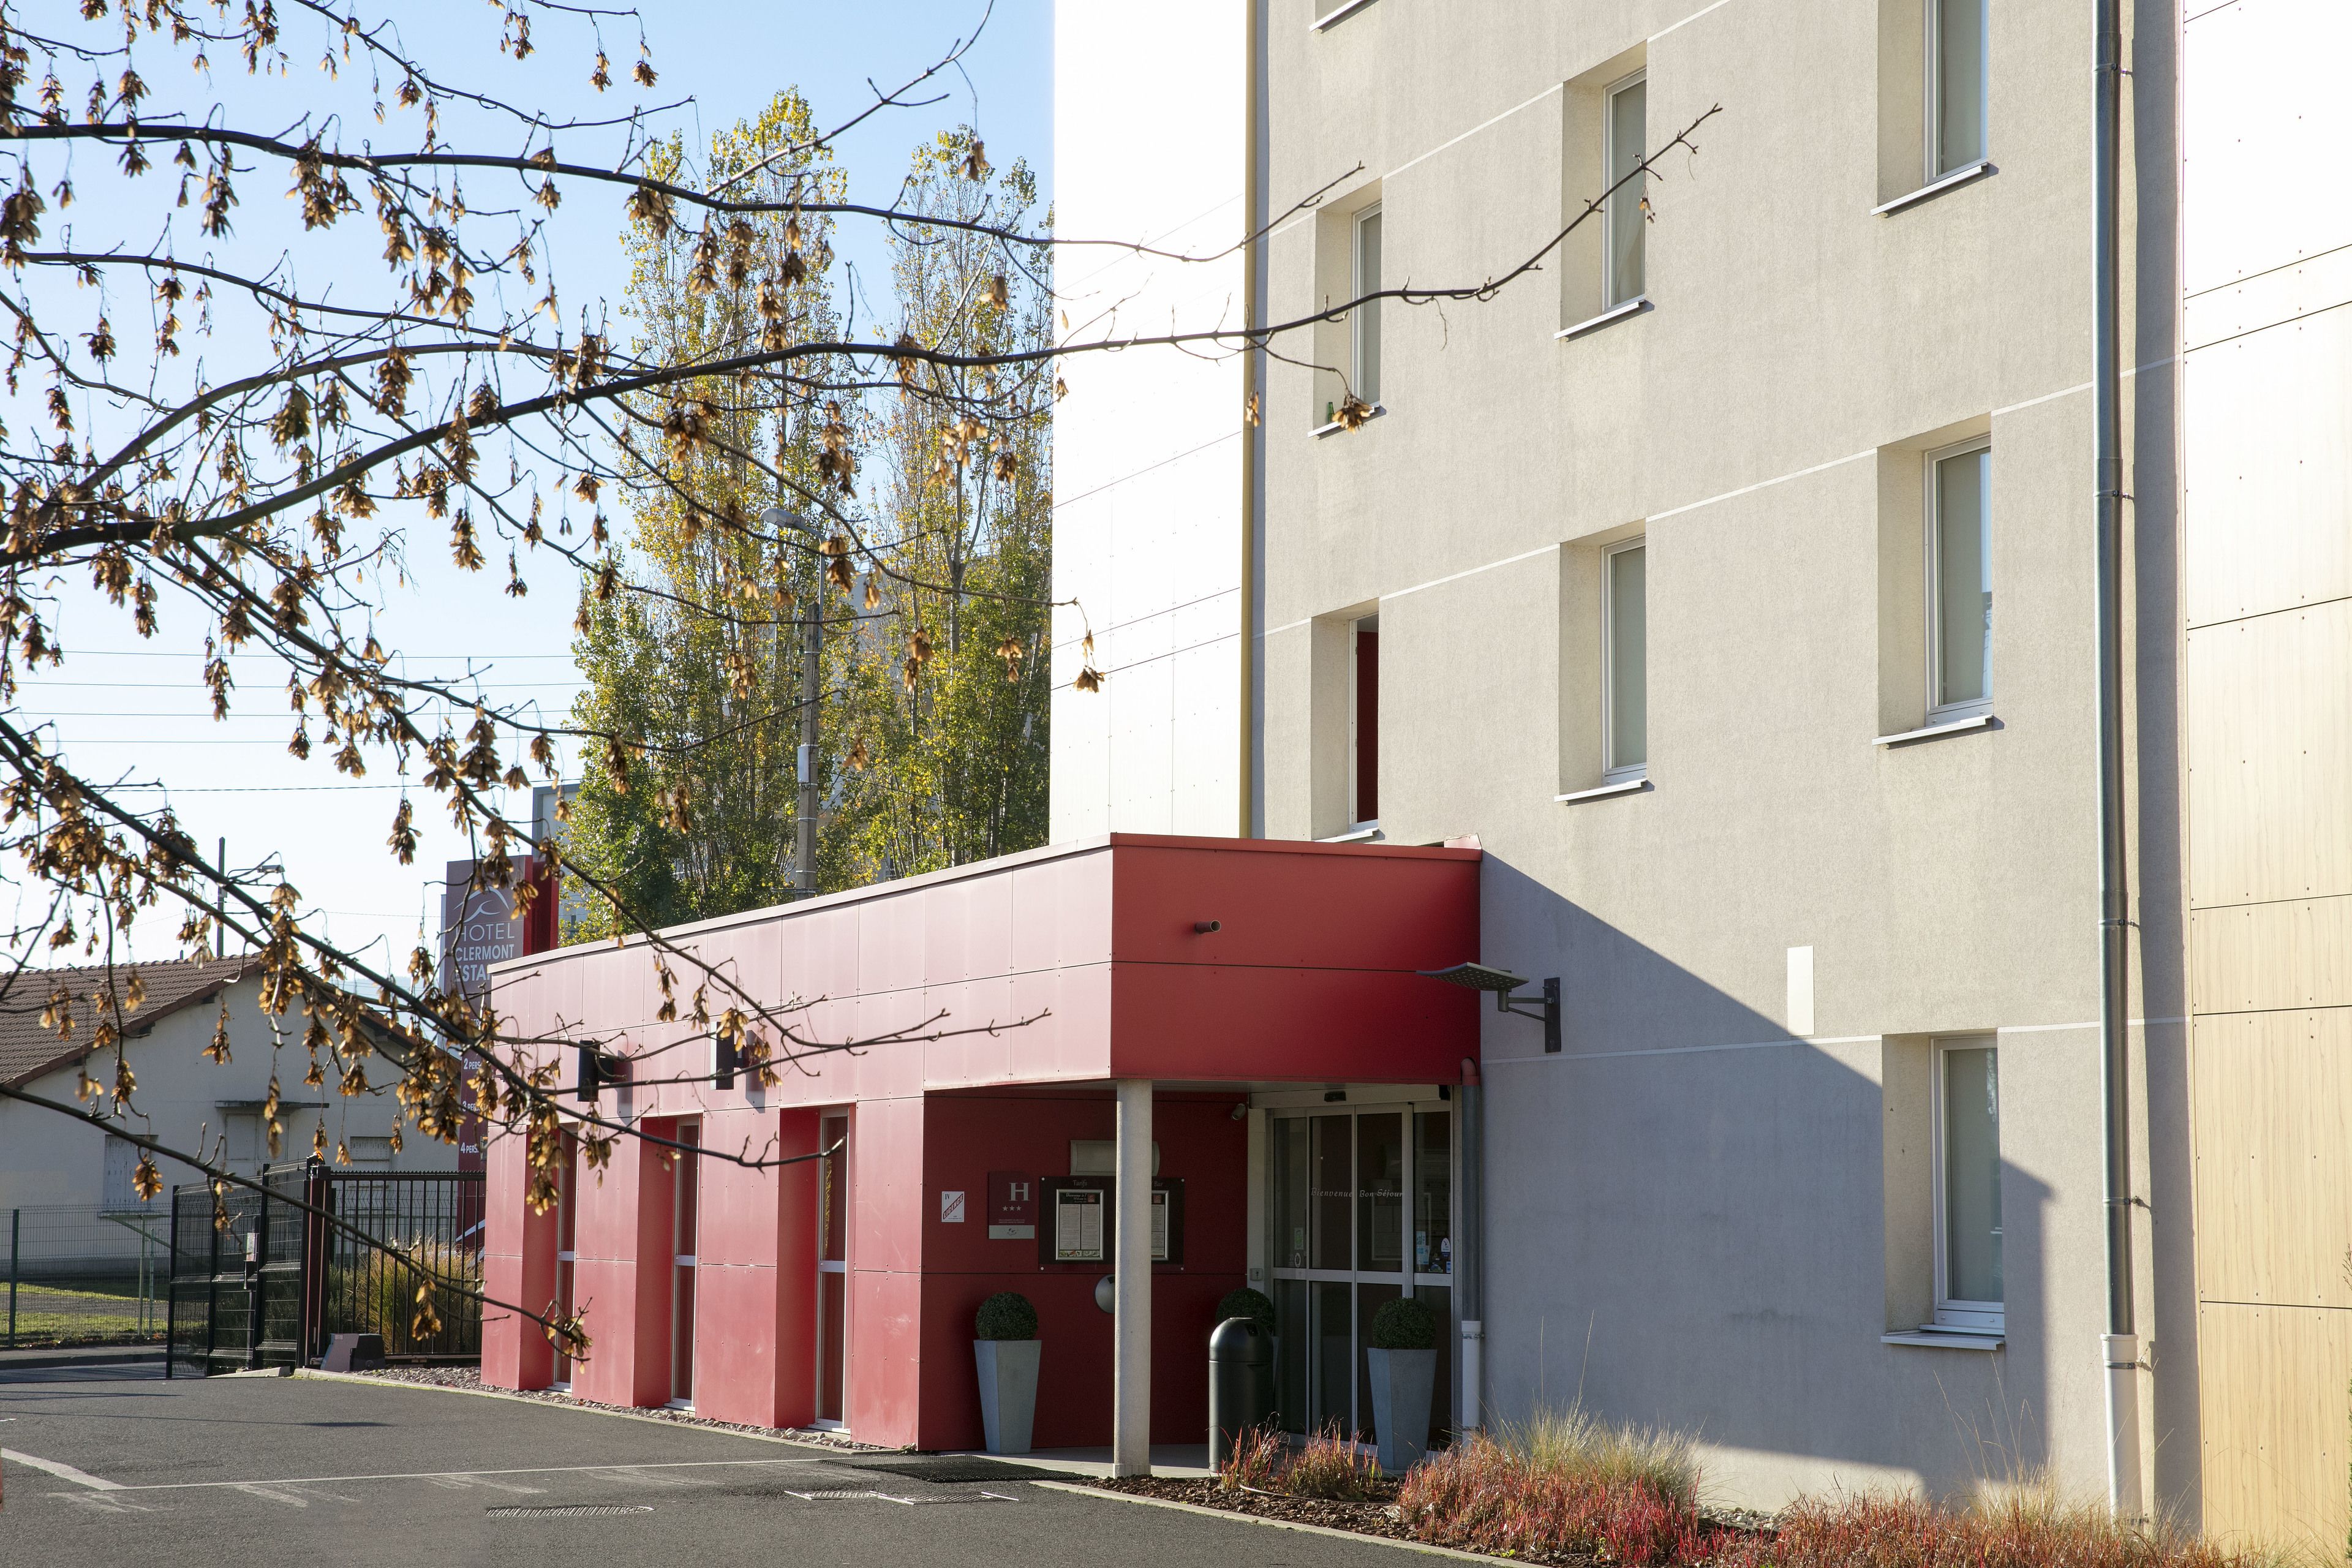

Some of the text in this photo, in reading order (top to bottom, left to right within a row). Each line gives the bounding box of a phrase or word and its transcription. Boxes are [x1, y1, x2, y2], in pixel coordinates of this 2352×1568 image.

[456, 922, 515, 941] HOTEL
[455, 944, 514, 962] CLERMONT
[464, 1058, 469, 1069] 2
[462, 1100, 467, 1112] 3
[460, 1142, 466, 1153] 4
[1009, 1182, 1030, 1201] H
[1311, 1187, 1352, 1197] Bienvenue
[1376, 1188, 1403, 1198] Séjour
[943, 1195, 963, 1219] LICENCE
